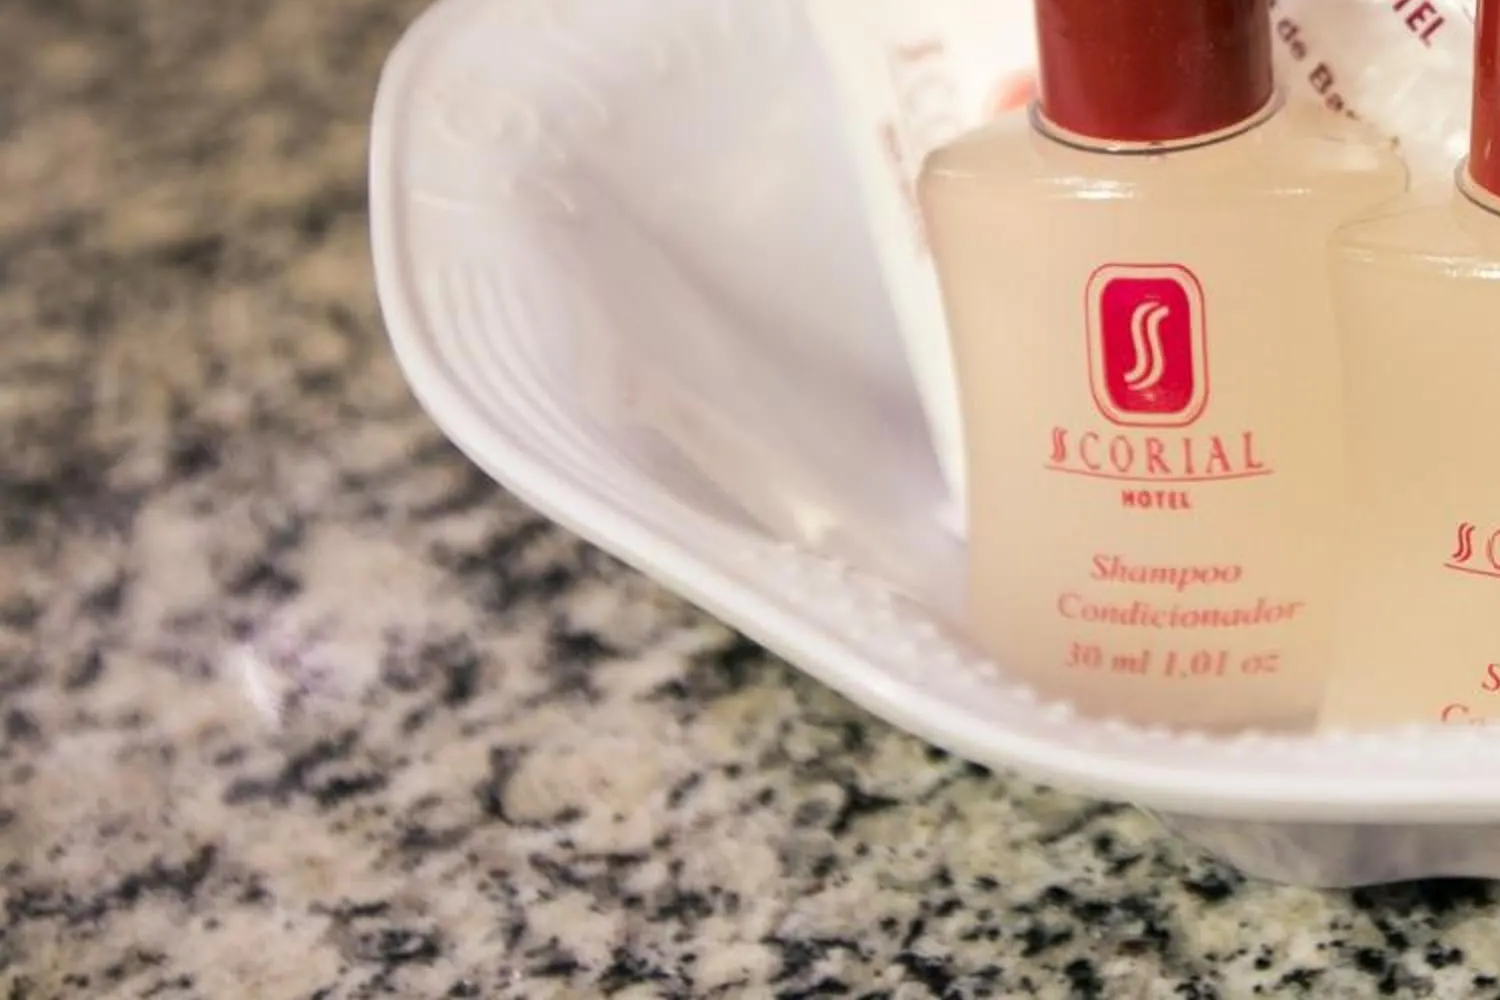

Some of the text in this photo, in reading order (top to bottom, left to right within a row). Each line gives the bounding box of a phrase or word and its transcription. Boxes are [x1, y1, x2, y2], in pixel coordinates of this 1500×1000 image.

[1049, 426, 1265, 475] SCORIAL
[1121, 490, 1192, 510] HOTEL
[1090, 553, 1243, 593] Shampoo
[1056, 591, 1307, 630] Condicionador
[1065, 641, 1281, 679] 30 ml 1.01 oz
